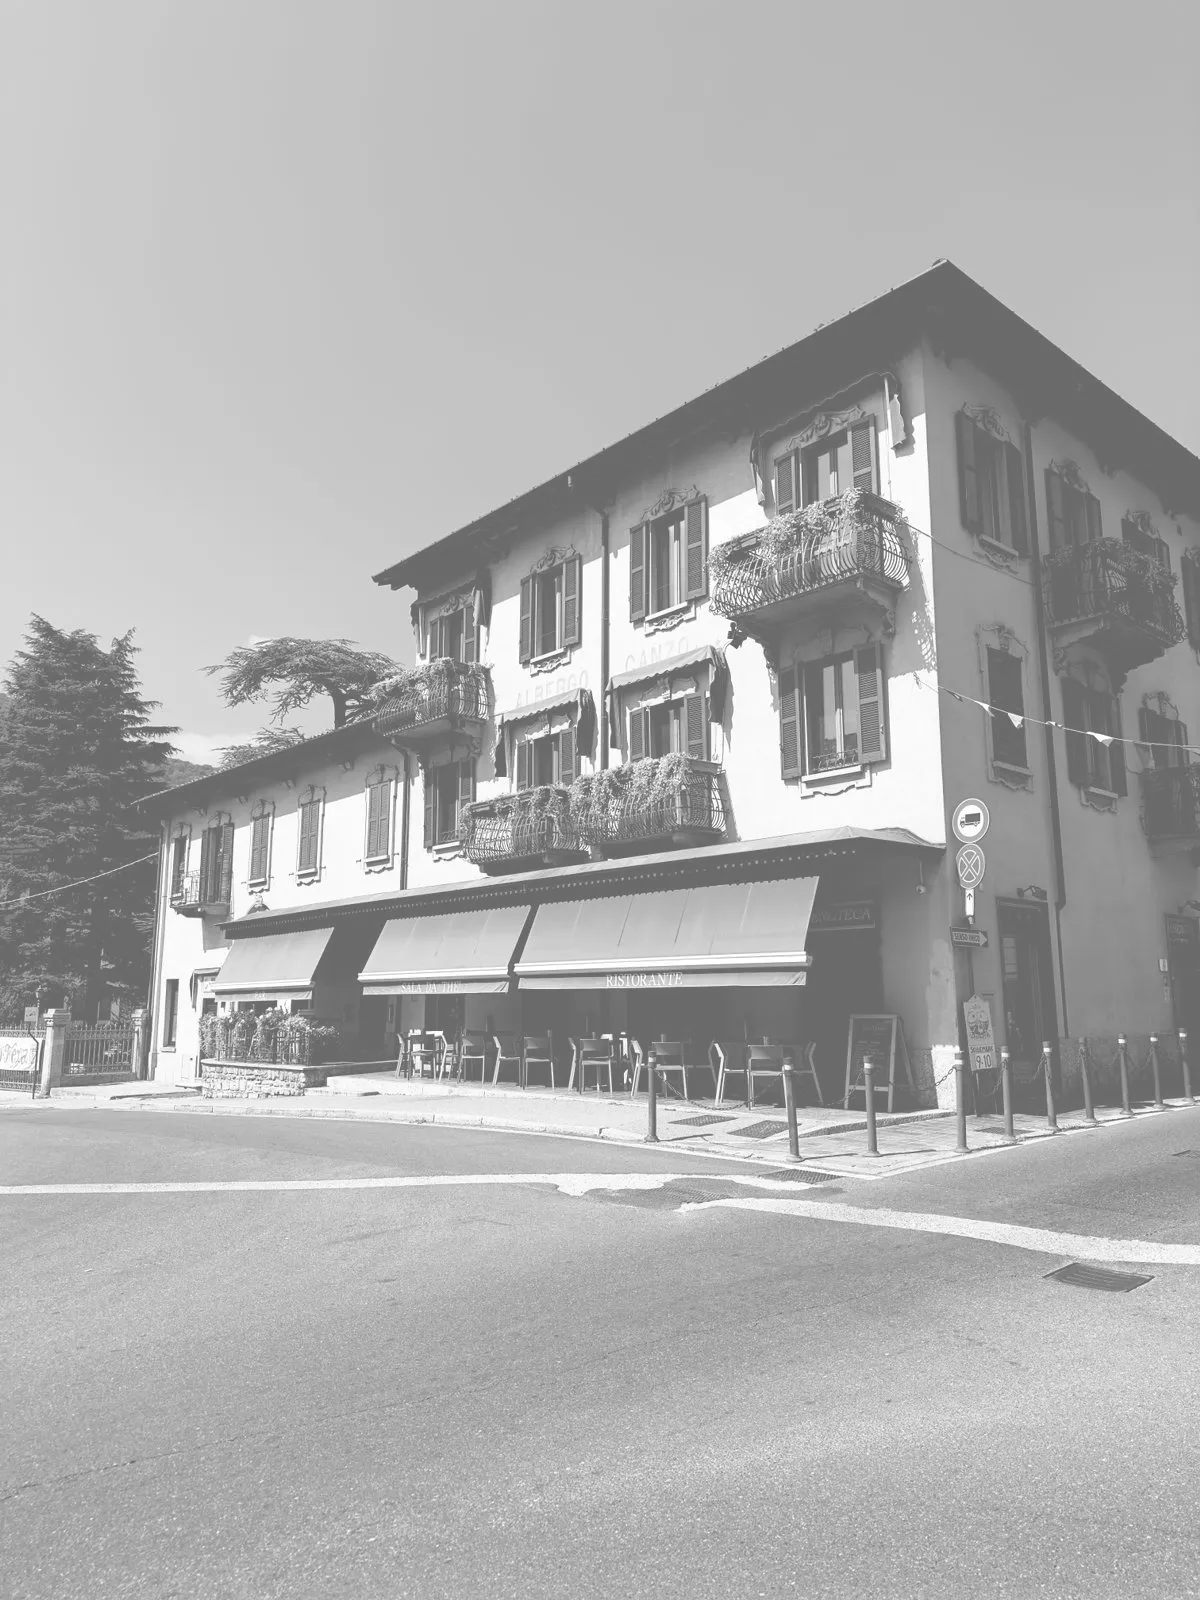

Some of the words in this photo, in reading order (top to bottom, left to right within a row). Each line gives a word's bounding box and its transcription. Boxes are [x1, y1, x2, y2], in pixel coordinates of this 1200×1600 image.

[625, 636, 689, 672] CANZO
[516, 669, 589, 708] ALBERGO
[401, 982, 421, 993] SALA
[605, 971, 684, 988] RISTORANTE
